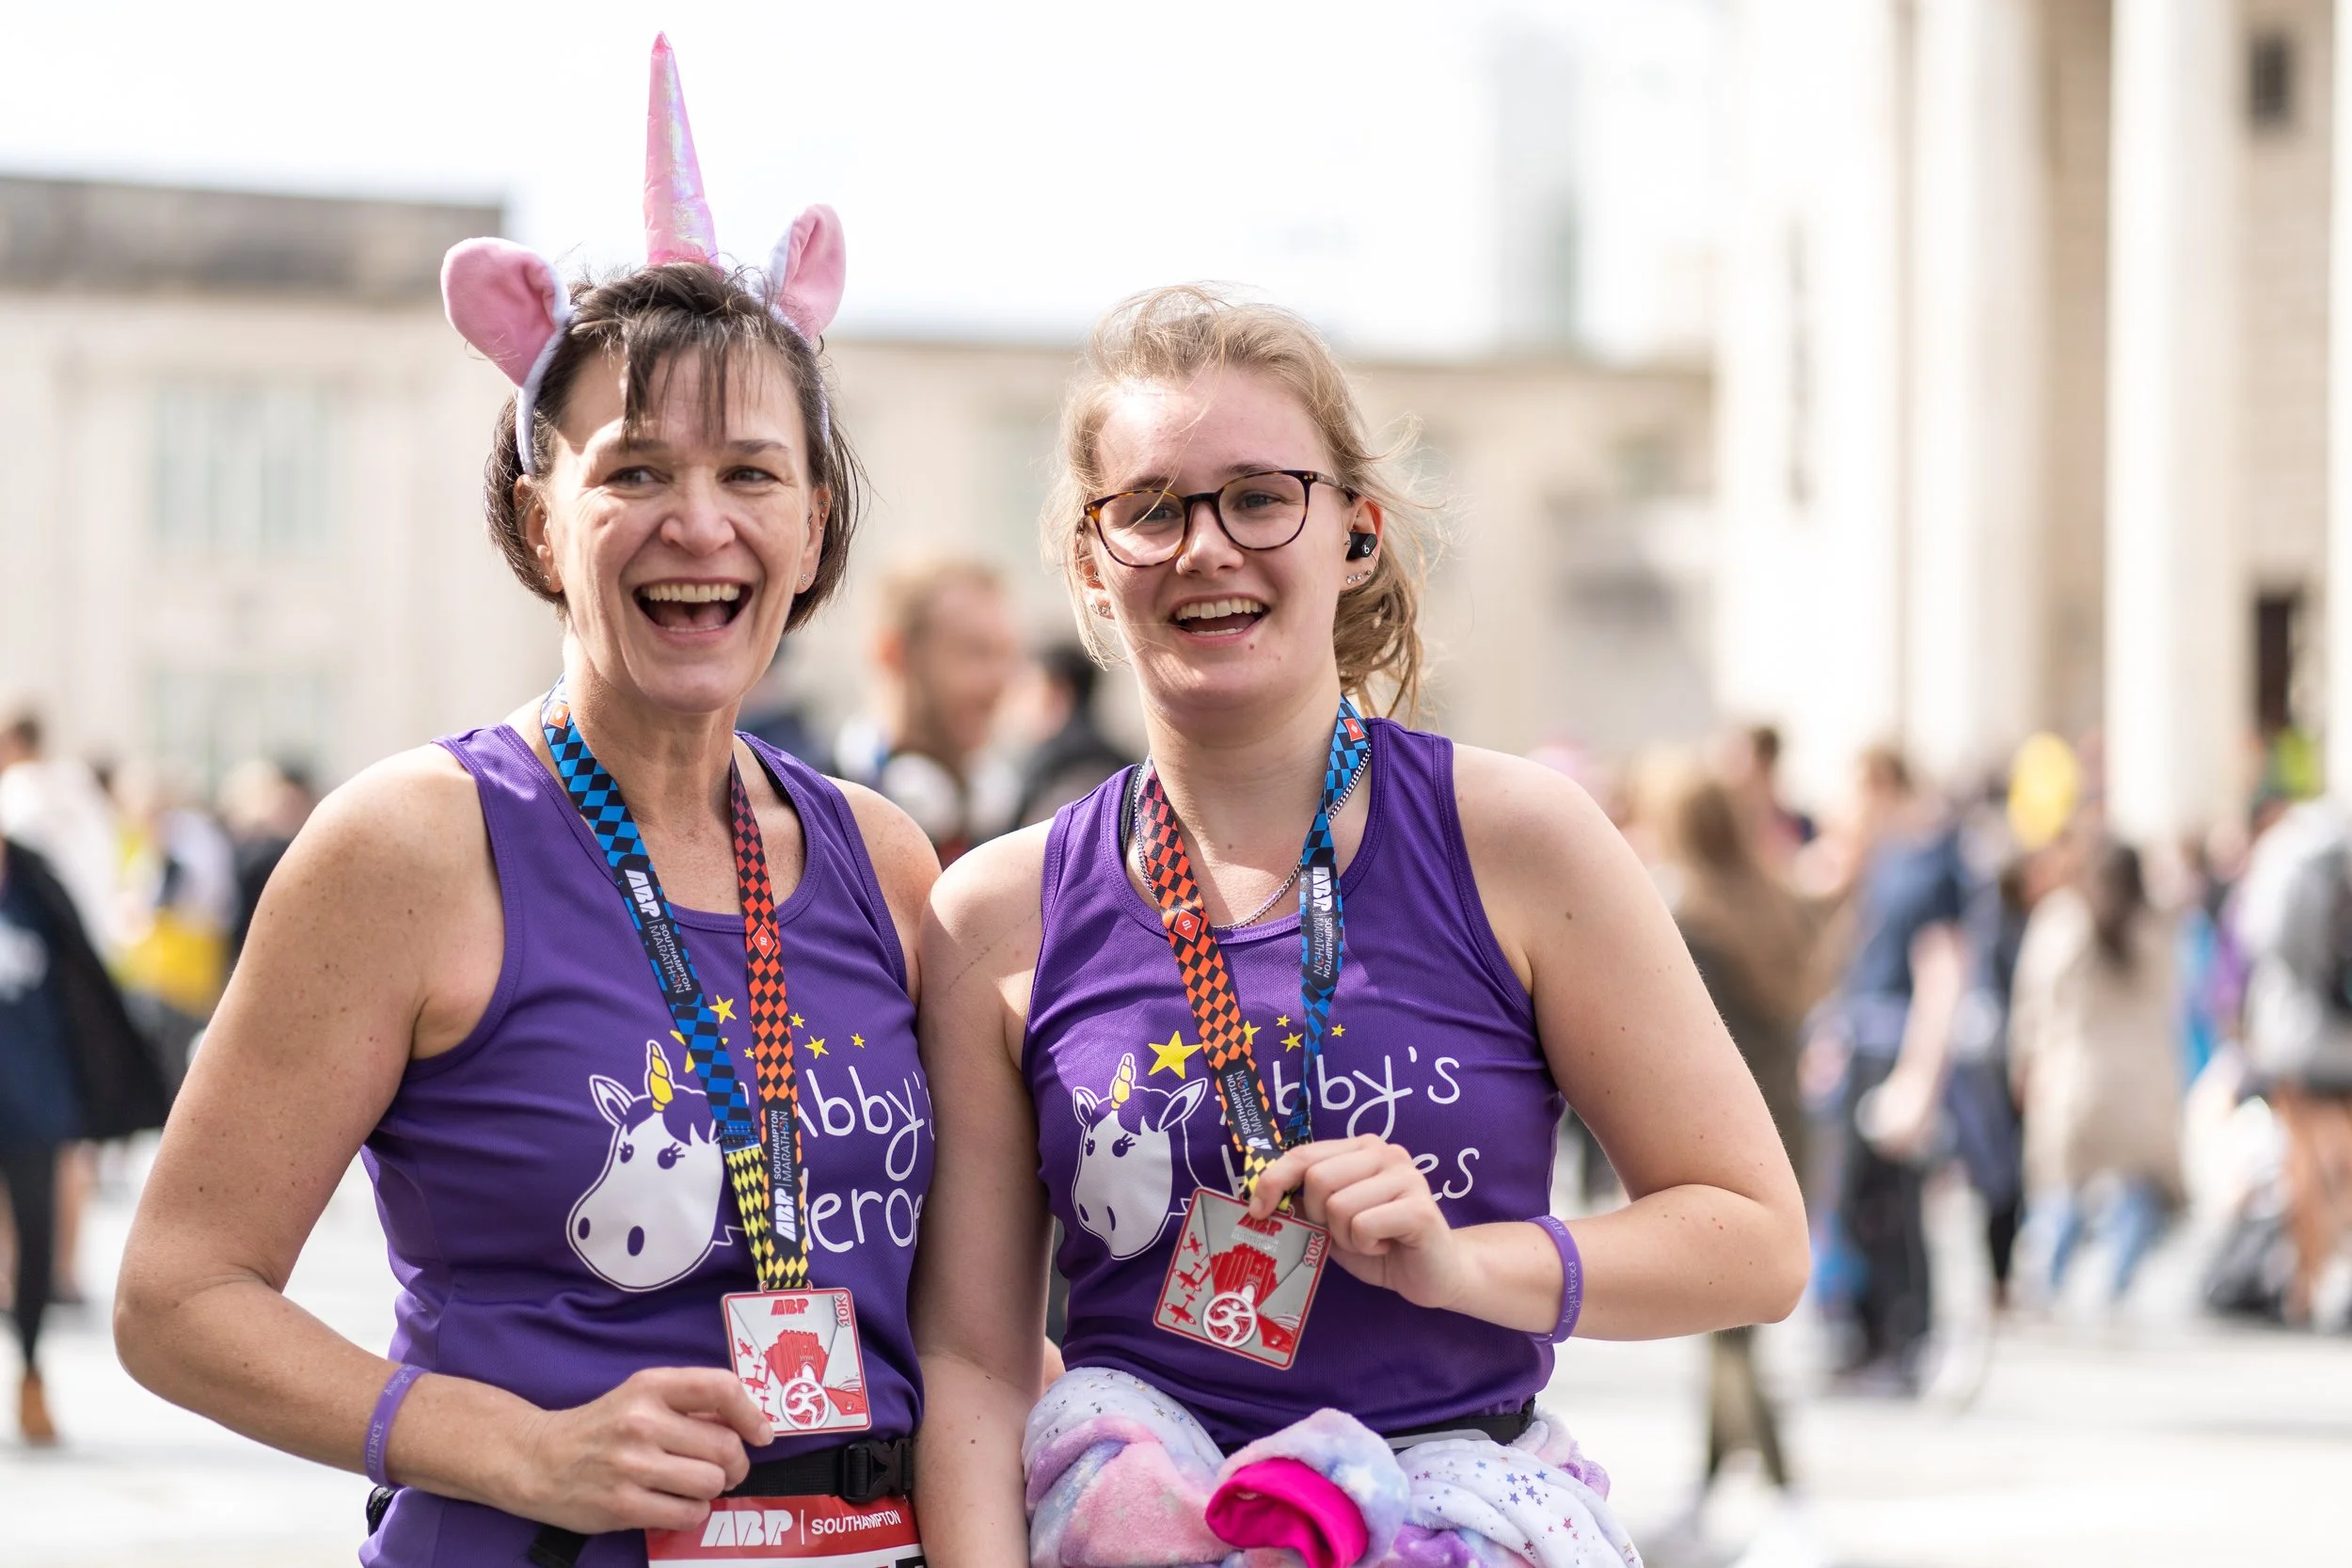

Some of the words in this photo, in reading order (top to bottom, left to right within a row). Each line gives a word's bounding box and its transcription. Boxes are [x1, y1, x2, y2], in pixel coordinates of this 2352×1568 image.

[1364, 544, 1370, 554] b
[625, 869, 660, 918] ABP
[1312, 866, 1332, 913] ABP
[759, 936, 768, 946] 10
[1182, 919, 1192, 930] 10
[1313, 916, 1325, 975] MARATHON
[1324, 917, 1333, 978] SOUTHAMPTON
[649, 925, 684, 994] MARATHON
[660, 923, 691, 991] SOUTHAMPTON
[1216, 1046, 1460, 1140] bby's
[1226, 1074, 1251, 1134] SOUTHAMPTON
[1235, 1069, 1263, 1132] MARATHON
[771, 1110, 782, 1180] SOUTHAMPTON
[779, 1110, 793, 1182] MARATHON
[774, 1187, 796, 1243] ABP
[1304, 1233, 1325, 1266] 10K
[1567, 1261, 1578, 1294] Heroes
[771, 1299, 809, 1315] ABP
[834, 1294, 851, 1327] 10K
[700, 1510, 793, 1547] ABP
[811, 1510, 901, 1535] SOUTHAMPTON
